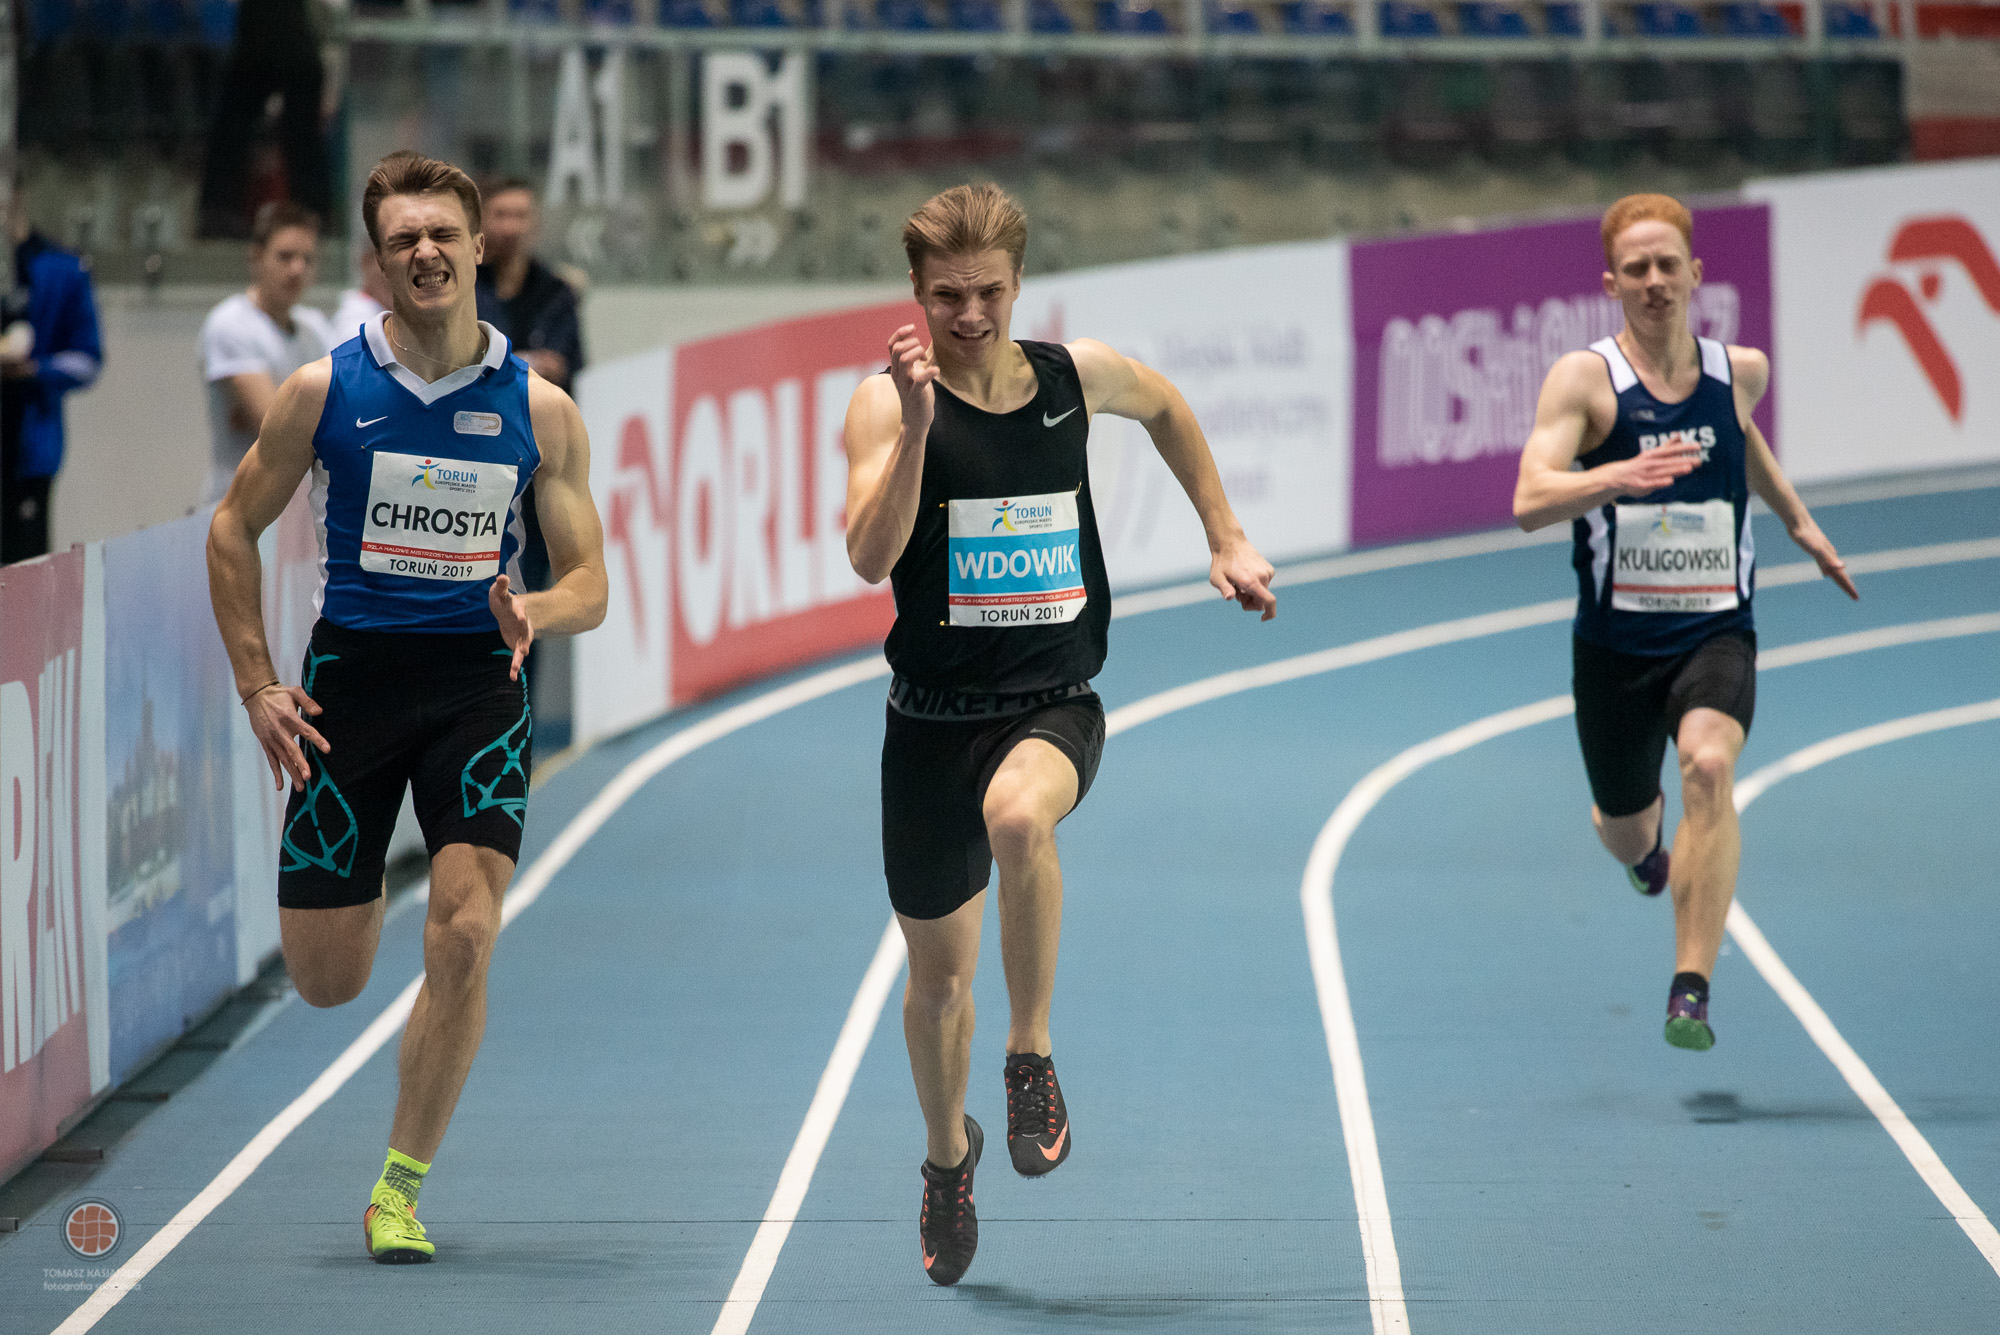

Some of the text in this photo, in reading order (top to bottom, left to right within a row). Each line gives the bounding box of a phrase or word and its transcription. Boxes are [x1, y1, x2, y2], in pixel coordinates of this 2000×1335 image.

[701, 50, 806, 208] B1
[371, 502, 497, 537] CHROSTA
[681, 359, 892, 648] ORLE
[389, 558, 473, 578] TORUŃ 2019
[955, 544, 1076, 580] WDOWIK
[1618, 548, 1730, 572] KULIGOWSKI
[980, 604, 1064, 622] TORUŃ 2019
